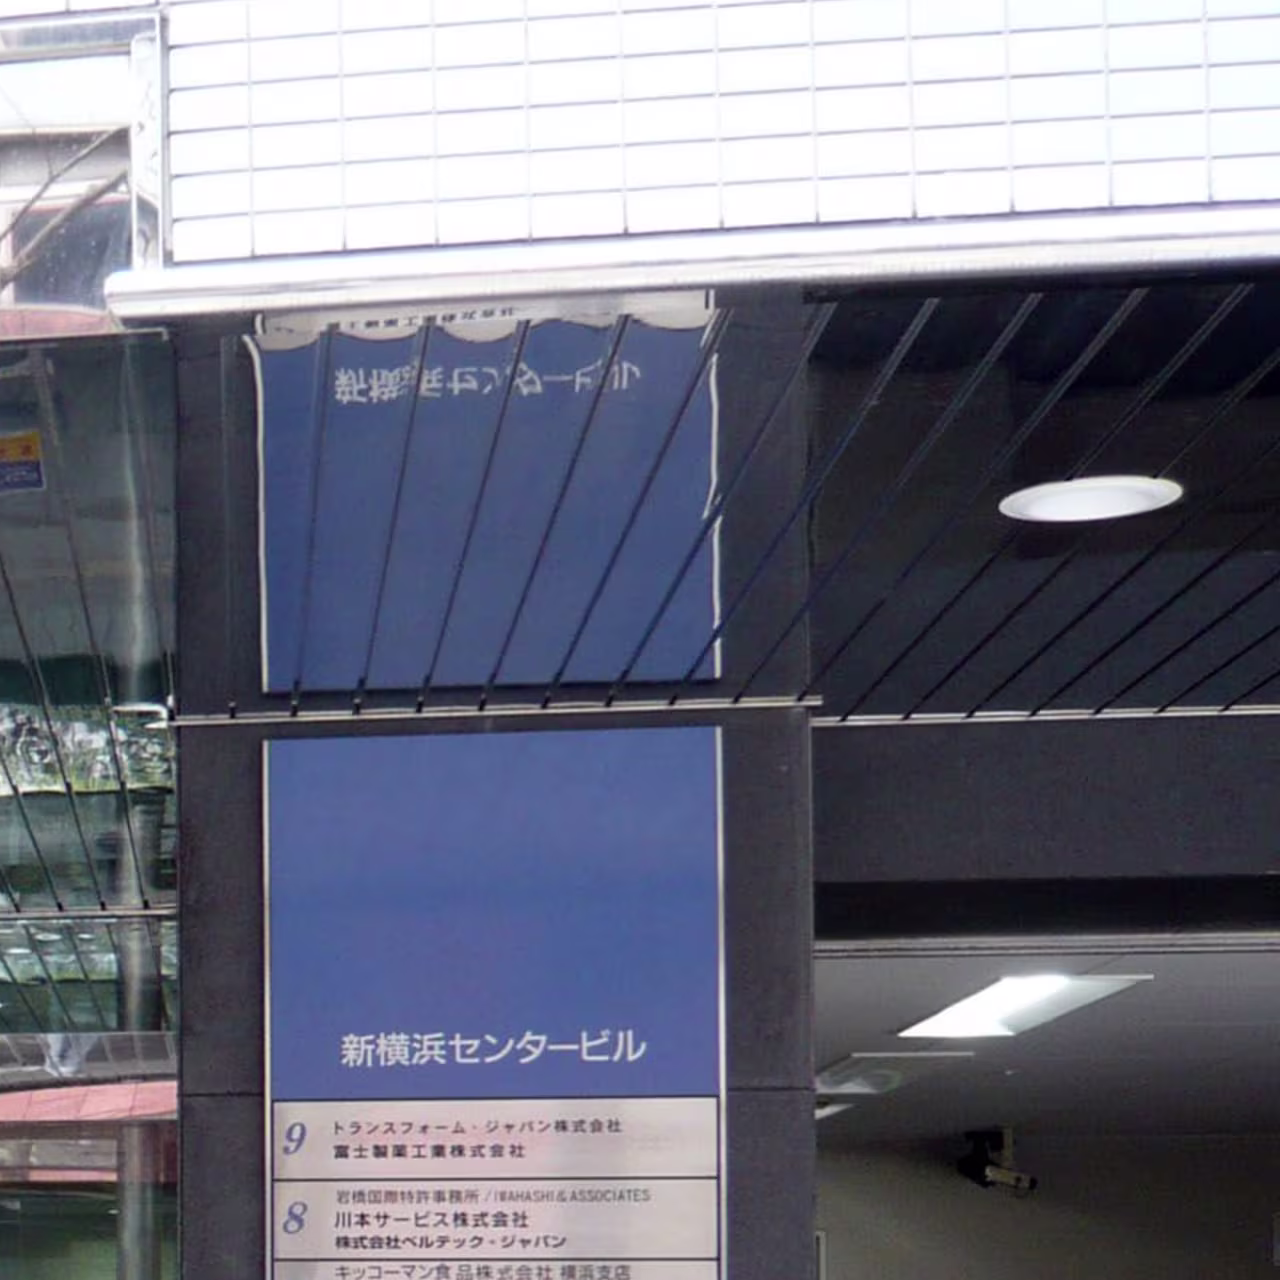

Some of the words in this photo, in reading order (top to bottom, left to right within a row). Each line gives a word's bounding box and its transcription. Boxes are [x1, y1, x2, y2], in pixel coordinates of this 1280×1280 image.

[339, 1029, 647, 1068] 新横浜センタービル
[282, 1122, 307, 1156] 9
[333, 1143, 527, 1160] 富士製薬工業株式会社
[282, 1201, 308, 1235] 8
[334, 1211, 529, 1229] 川本サービス株式会社
[335, 1234, 567, 1250] 株式会社ベルテック・ジャパン
